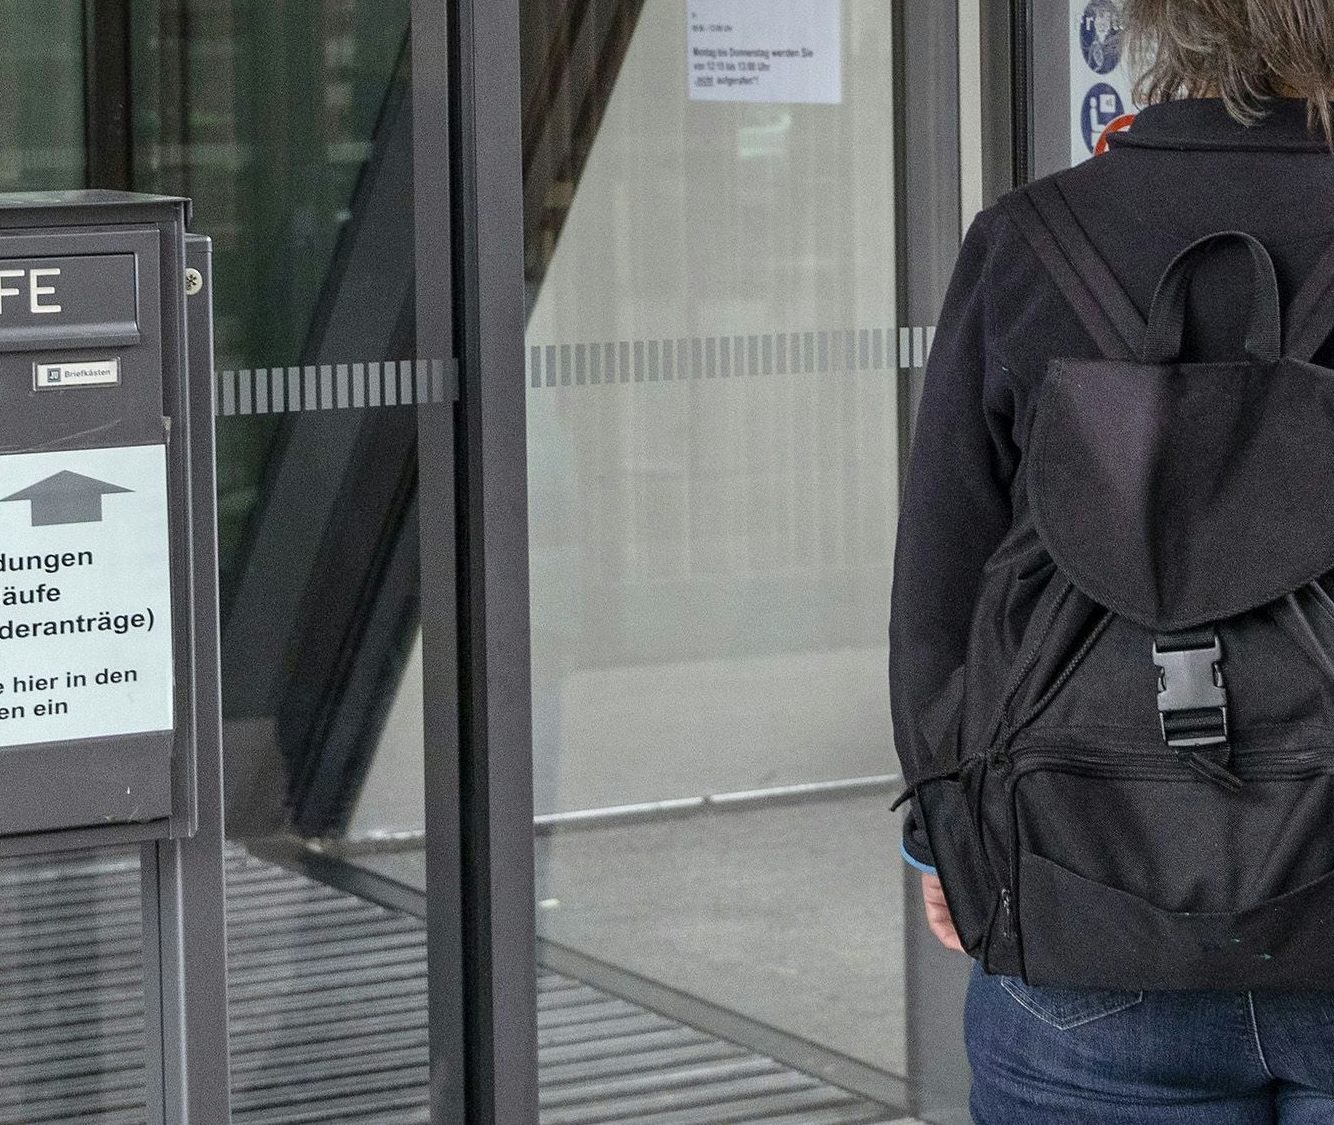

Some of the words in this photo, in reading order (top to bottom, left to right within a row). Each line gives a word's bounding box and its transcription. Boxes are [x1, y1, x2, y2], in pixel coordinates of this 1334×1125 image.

[13, 674, 59, 693] hier
[66, 671, 86, 688] in
[95, 667, 138, 686] den
[33, 699, 69, 718] ein
